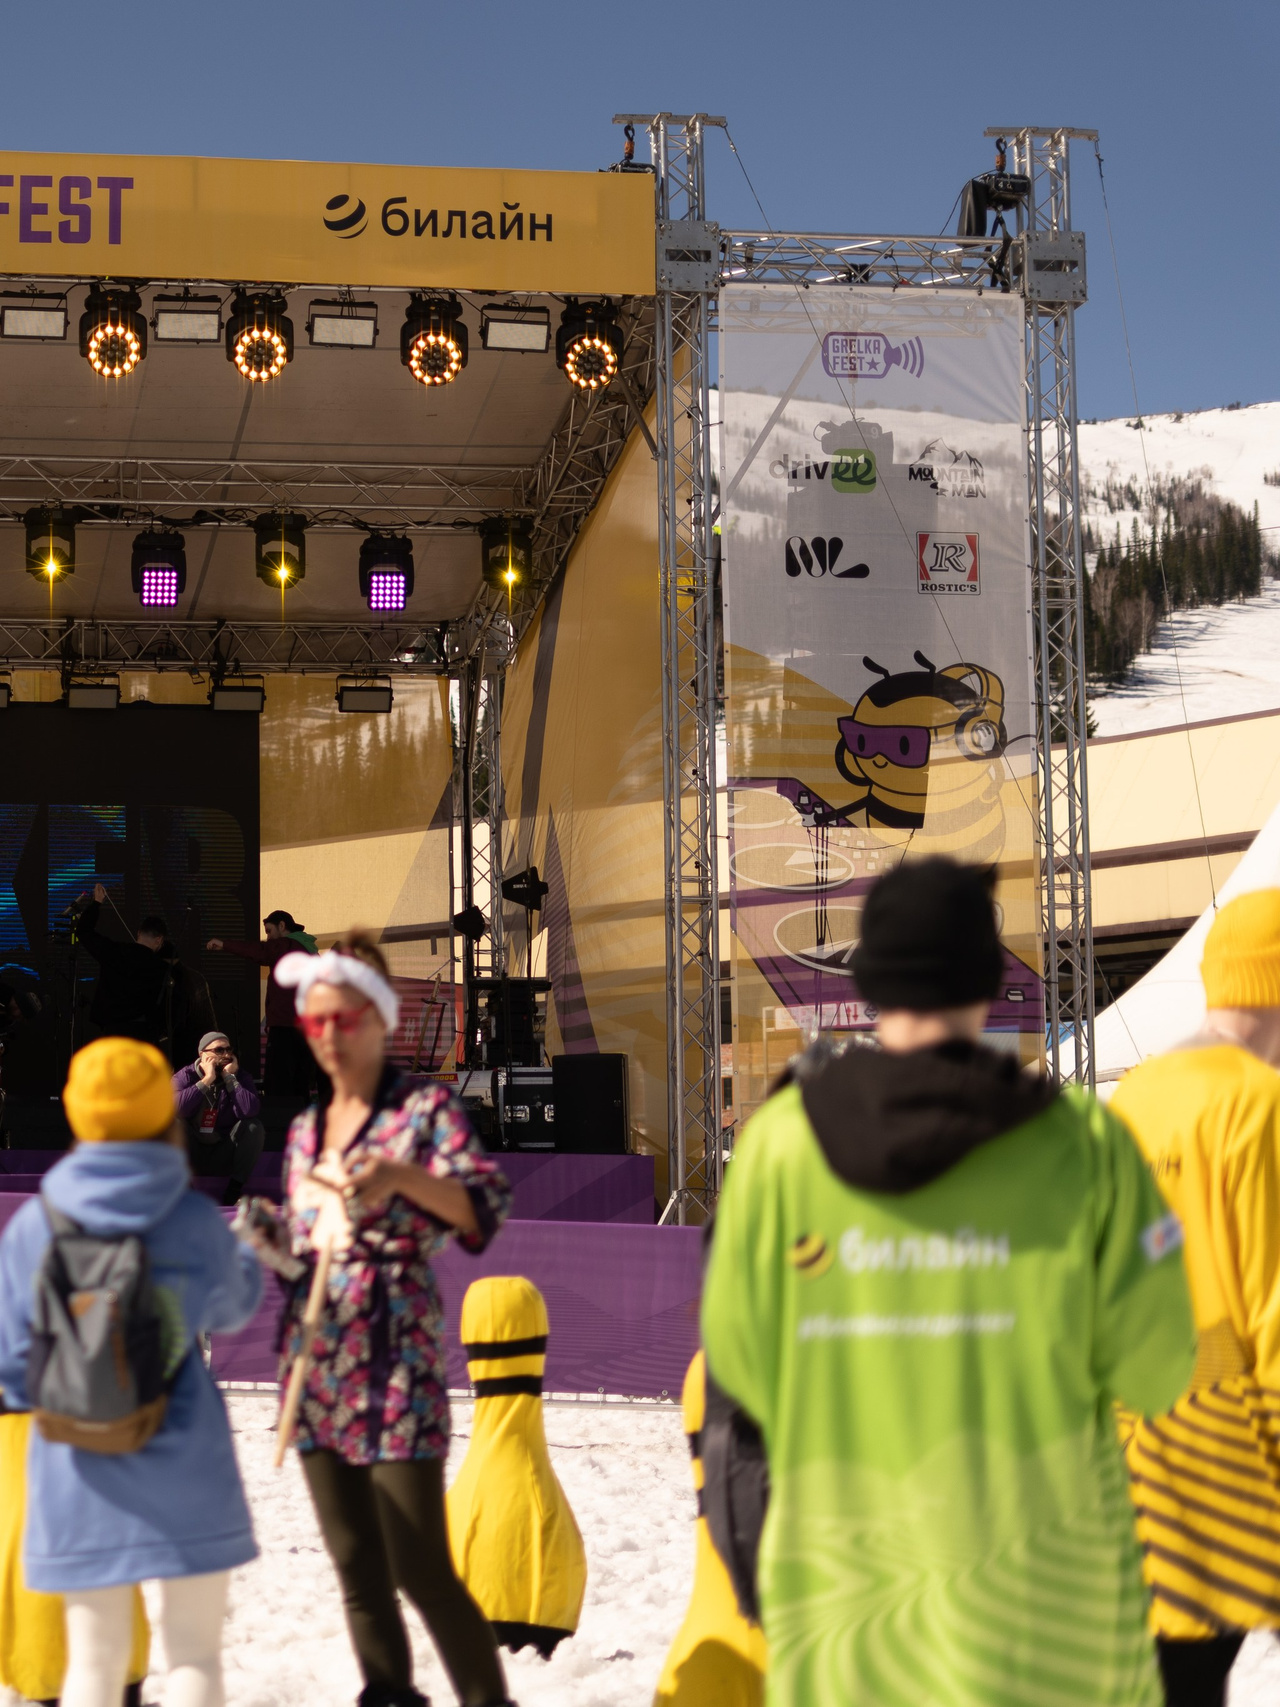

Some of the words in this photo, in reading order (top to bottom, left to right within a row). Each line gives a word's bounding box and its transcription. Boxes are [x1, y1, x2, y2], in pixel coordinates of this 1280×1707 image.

[381, 196, 553, 242] билайн
[832, 338, 880, 354] GRELKA
[832, 356, 865, 371] FEST
[921, 583, 977, 592] ROSTIC'S
[839, 1226, 1011, 1274] билайн
